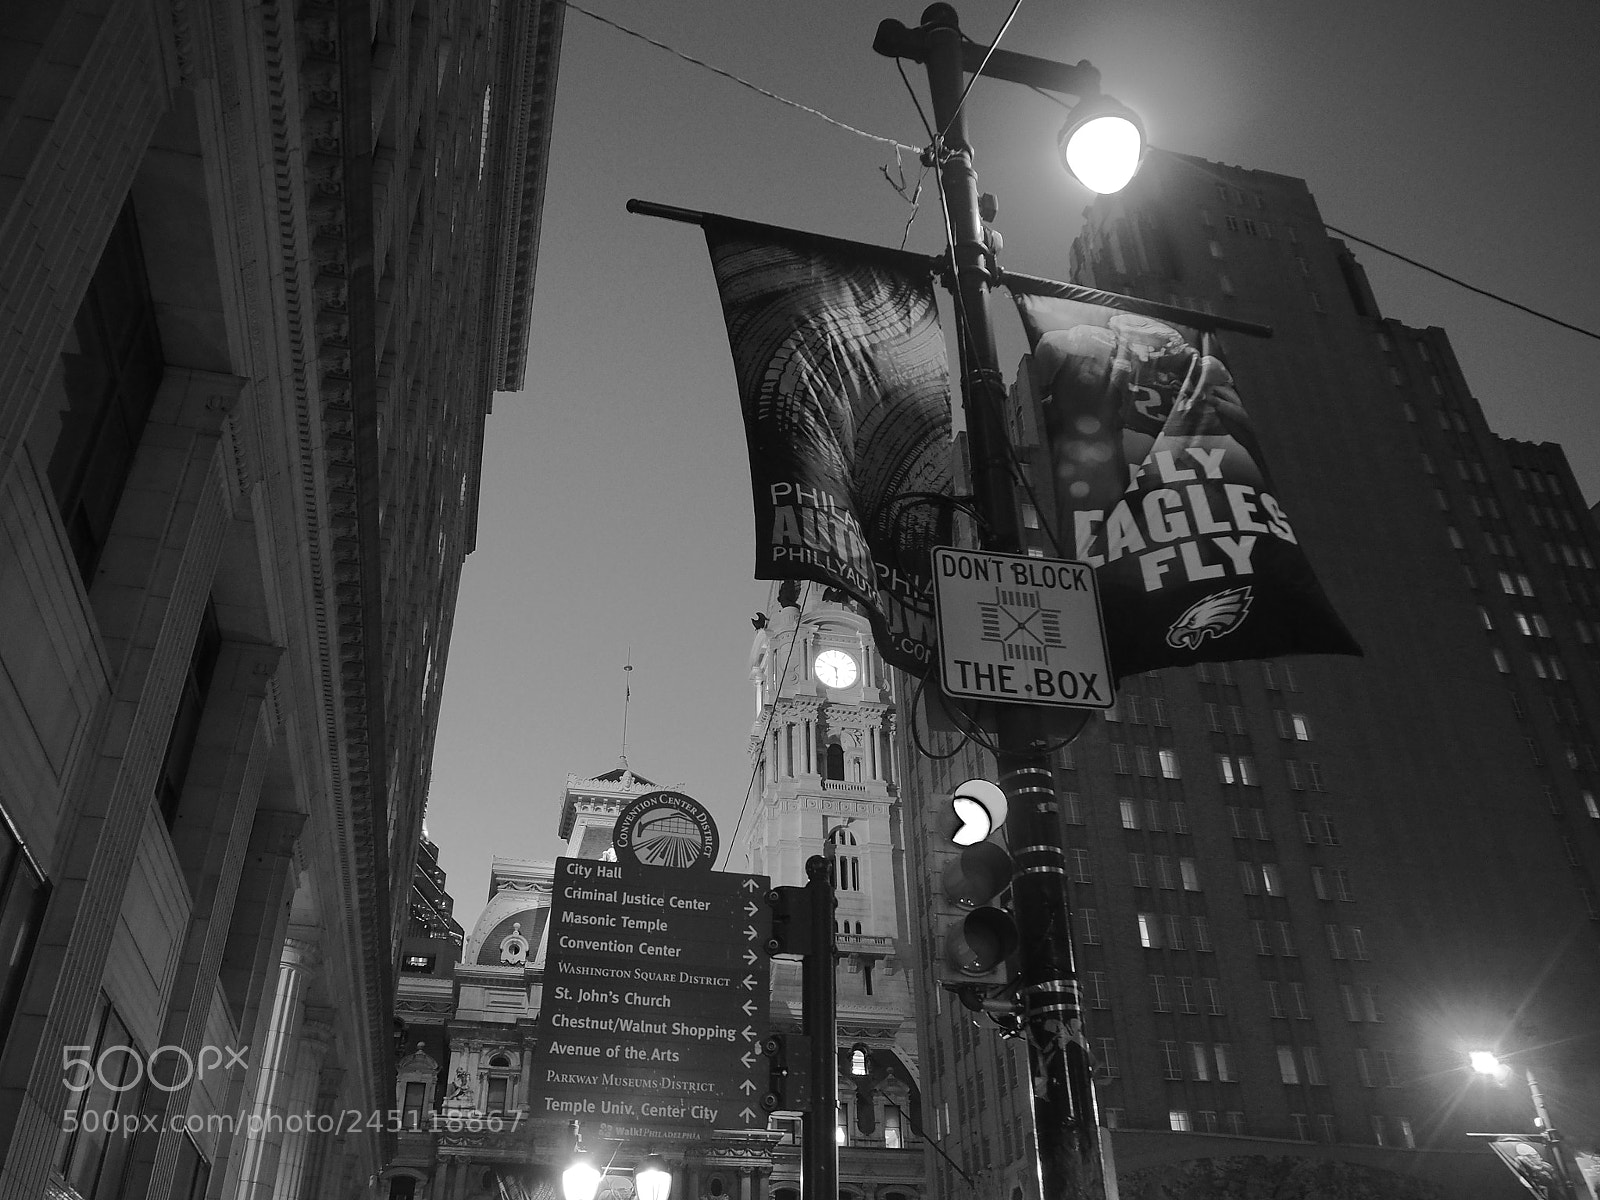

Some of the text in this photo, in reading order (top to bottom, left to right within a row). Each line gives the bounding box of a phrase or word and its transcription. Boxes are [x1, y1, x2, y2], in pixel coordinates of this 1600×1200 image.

[1073, 483, 1298, 570] EAGLES
[941, 554, 1088, 592] DON'T BLOCK
[1139, 535, 1257, 592] FLY
[954, 660, 1102, 701] THE BOX
[566, 863, 622, 879] City Hall
[564, 886, 711, 911] Criminal Justice Center
[561, 911, 668, 933] Masonic Temple
[559, 936, 681, 958] Convention Center
[554, 986, 671, 1008] St. John's Church
[552, 1014, 737, 1042] Chestnut/Walnut Shopping
[549, 1041, 680, 1062] Avenue of the Arts
[544, 1097, 718, 1123] Temple Univ. Center City
